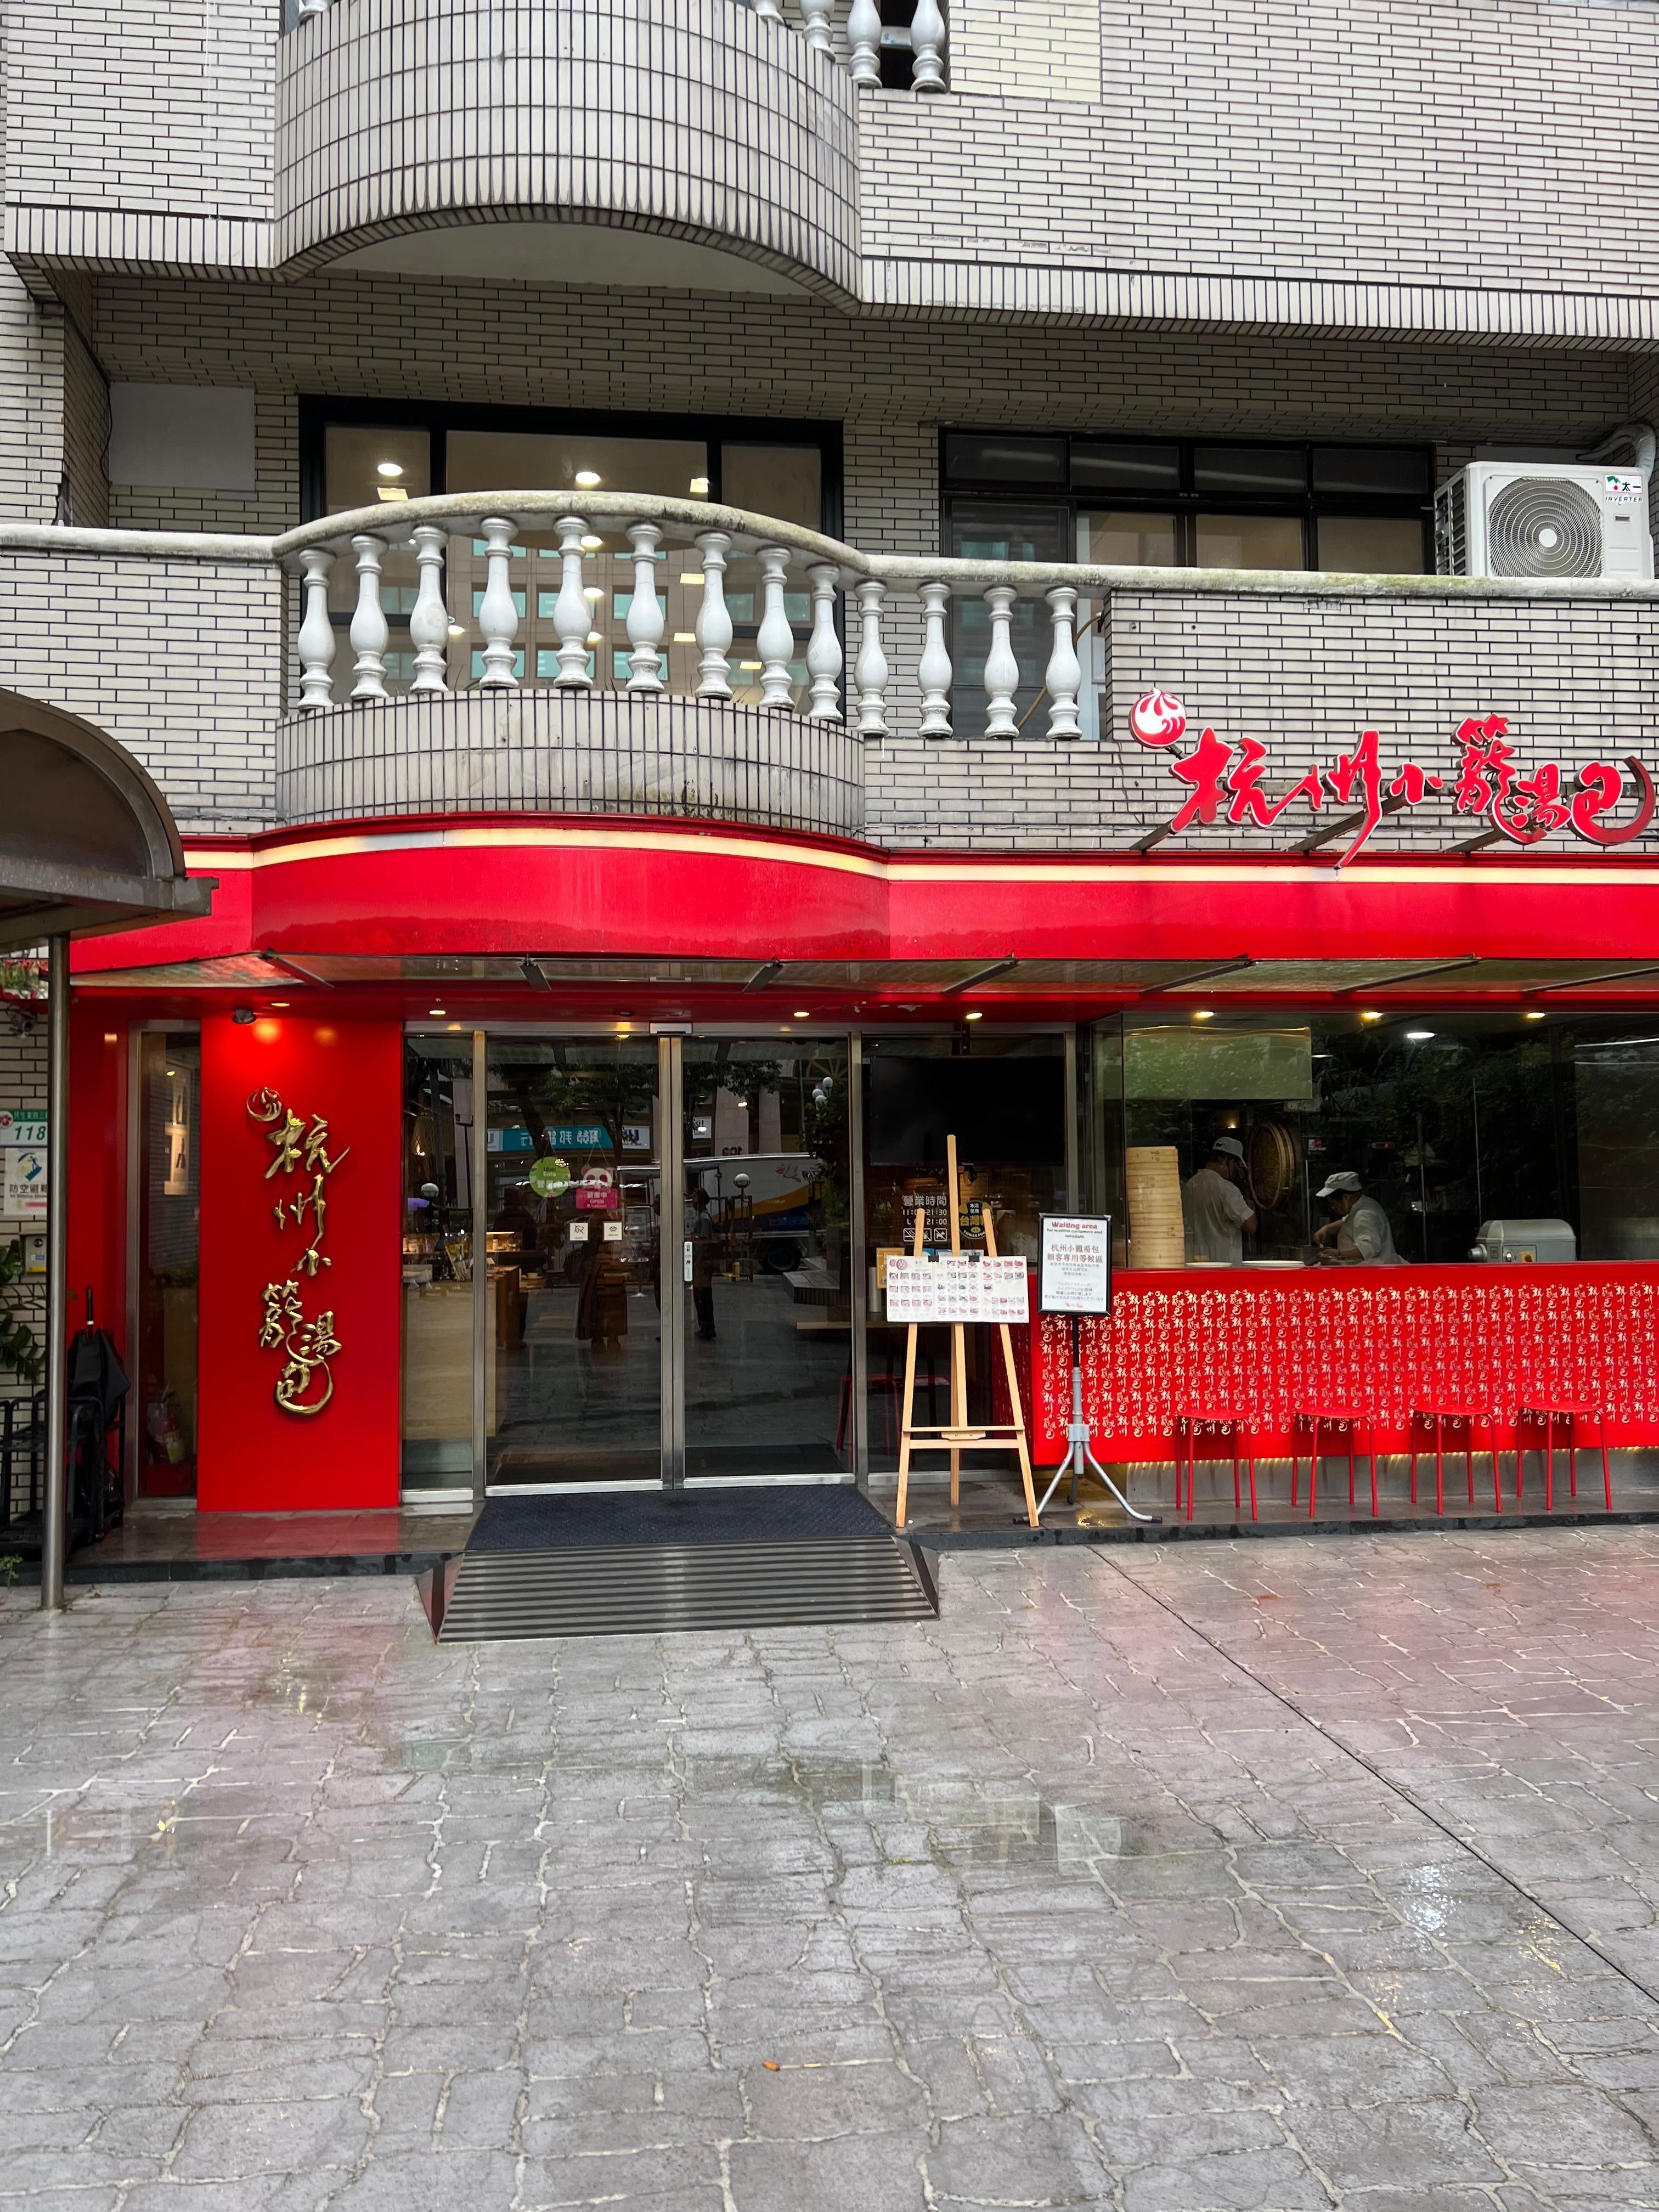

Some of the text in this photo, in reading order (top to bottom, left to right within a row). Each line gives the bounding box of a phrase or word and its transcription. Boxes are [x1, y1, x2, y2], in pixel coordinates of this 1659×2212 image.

[1622, 481, 1641, 492] 太一
[14, 1110, 48, 1120] 民生東路三
[14, 1125, 47, 1141] 118
[902, 1195, 947, 1207] 營業時間
[960, 1215, 985, 1227] 台灣
[1051, 1221, 1080, 1229] Waiting
[1051, 1243, 1099, 1254] 杭州小籠湯包
[1047, 1253, 1104, 1263] 顧客專用等候區
